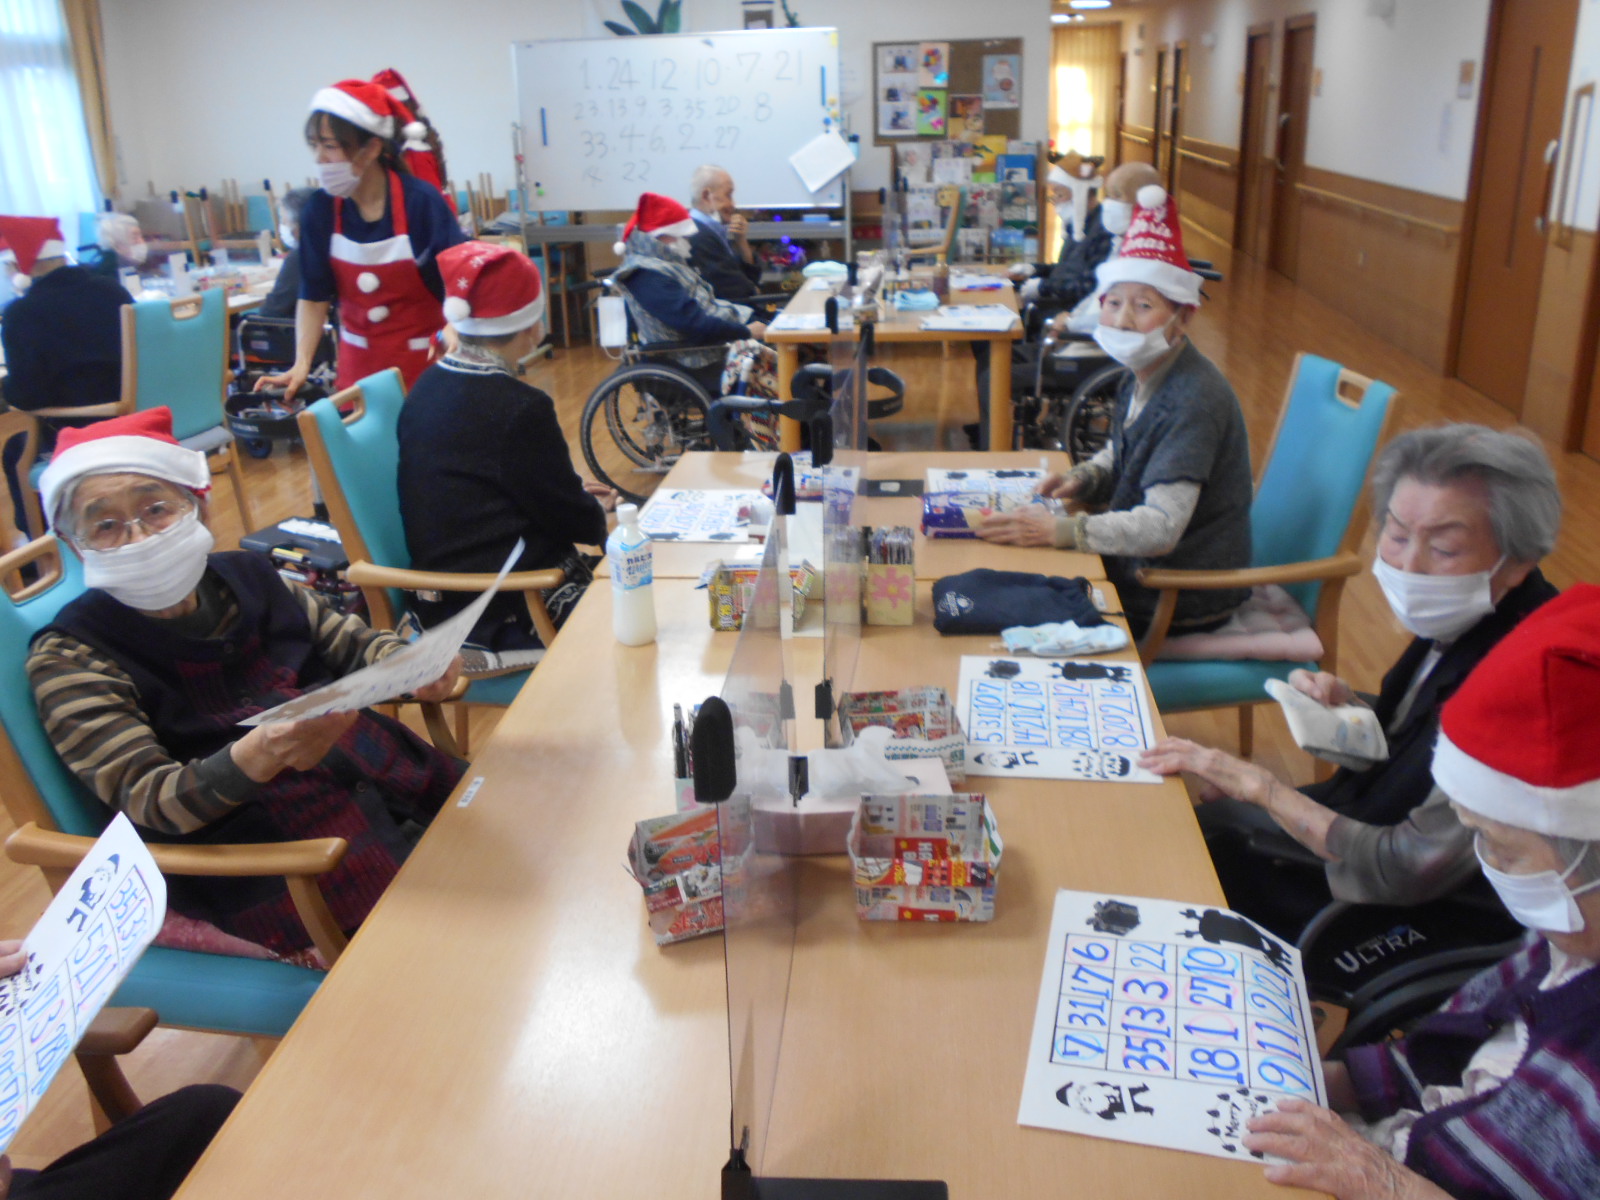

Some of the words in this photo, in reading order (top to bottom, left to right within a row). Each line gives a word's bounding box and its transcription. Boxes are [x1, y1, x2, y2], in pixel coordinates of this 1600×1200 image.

[651, 57, 678, 90] 12
[696, 57, 721, 90] 10
[736, 51, 762, 82] 7
[775, 49, 803, 85] 21
[973, 693, 1005, 712] 10
[1011, 681, 1043, 696] 18
[977, 712, 1002, 728] 31
[974, 732, 1004, 743] 5
[1012, 728, 1049, 746] 14
[1102, 734, 1140, 748] 8
[74, 922, 104, 965] 5
[1071, 942, 1111, 962] 6
[1128, 942, 1167, 973] 22
[1333, 928, 1427, 974] ULTRA
[1185, 946, 1236, 978] 10
[1071, 964, 1115, 1001] 17
[1122, 977, 1169, 1000] 3
[1189, 976, 1233, 1010] 27
[1068, 999, 1107, 1027] 31
[1121, 1005, 1172, 1039] 13
[1251, 992, 1298, 1027] 2
[1062, 1033, 1106, 1057] 7
[1183, 1023, 1239, 1041] 1
[1254, 1020, 1304, 1062] 11
[1122, 1035, 1171, 1072] 35
[1188, 1048, 1245, 1085] 18
[1257, 1056, 1312, 1092] 9
